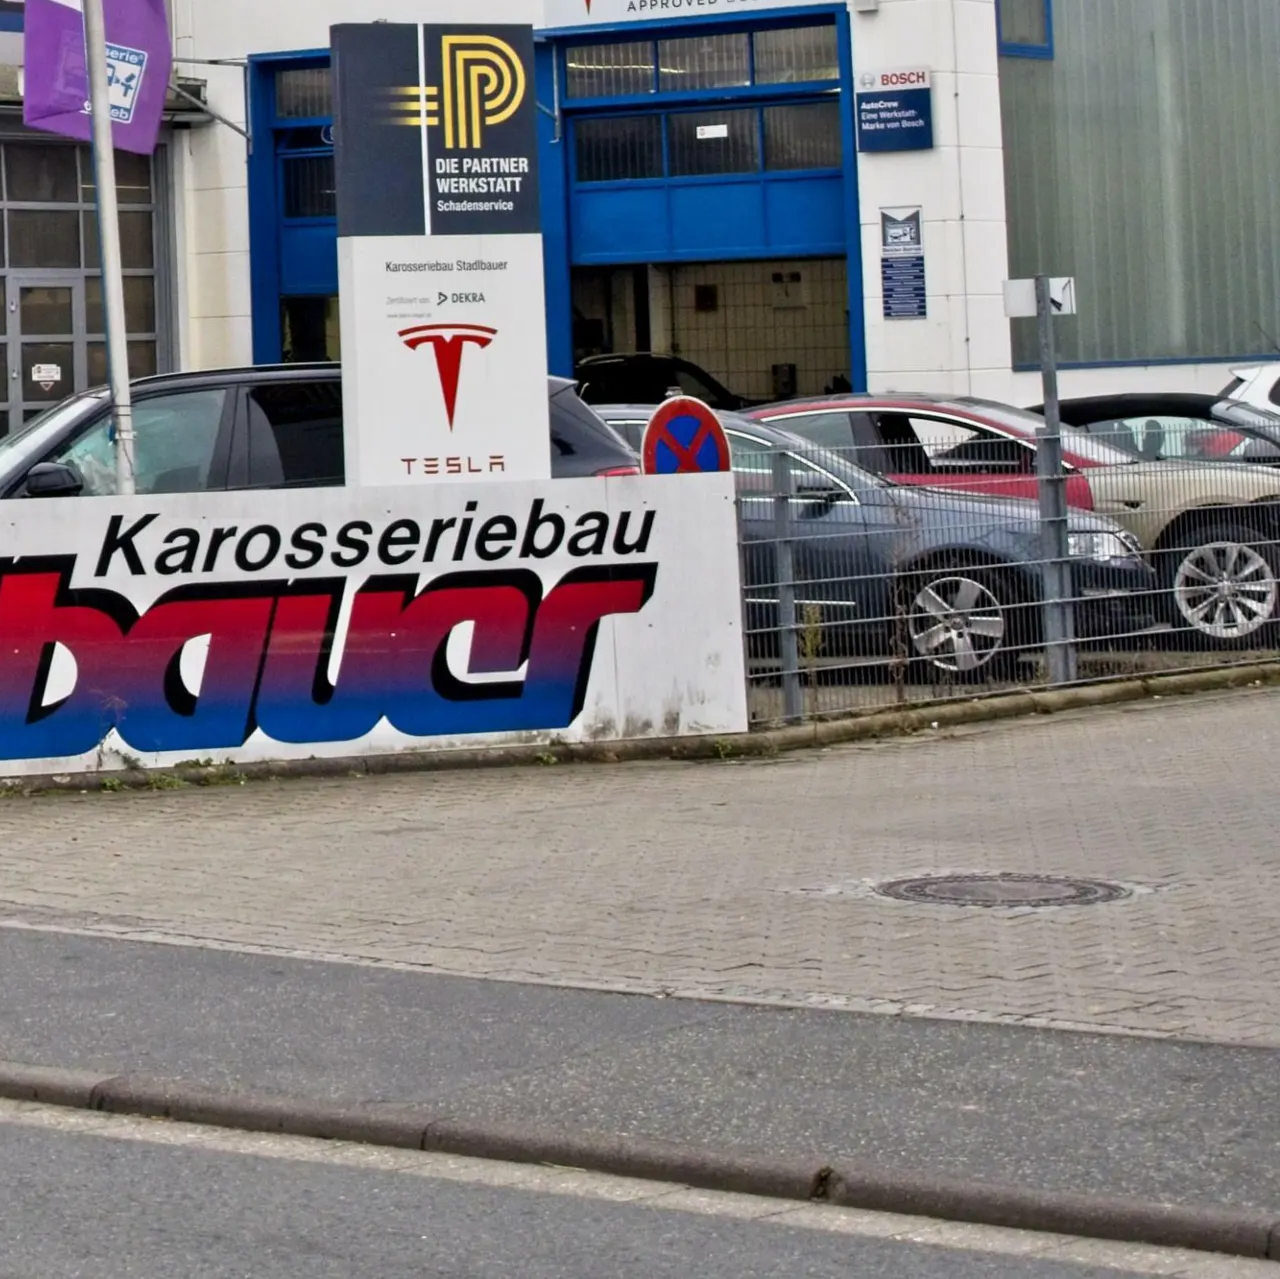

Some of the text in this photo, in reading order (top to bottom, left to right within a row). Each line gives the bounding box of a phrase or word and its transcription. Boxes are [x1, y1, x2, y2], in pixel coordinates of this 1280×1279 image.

[881, 71, 926, 86] BOSCH
[435, 157, 529, 174] DIE PARTNER
[436, 177, 522, 193] WERKSTATT
[437, 199, 514, 212] Schadenservice
[385, 260, 509, 273] Karosseriebau Stadlbauer
[451, 292, 485, 303] DEKRA
[400, 455, 505, 475] TESLA
[94, 498, 657, 577] Karosseriebau
